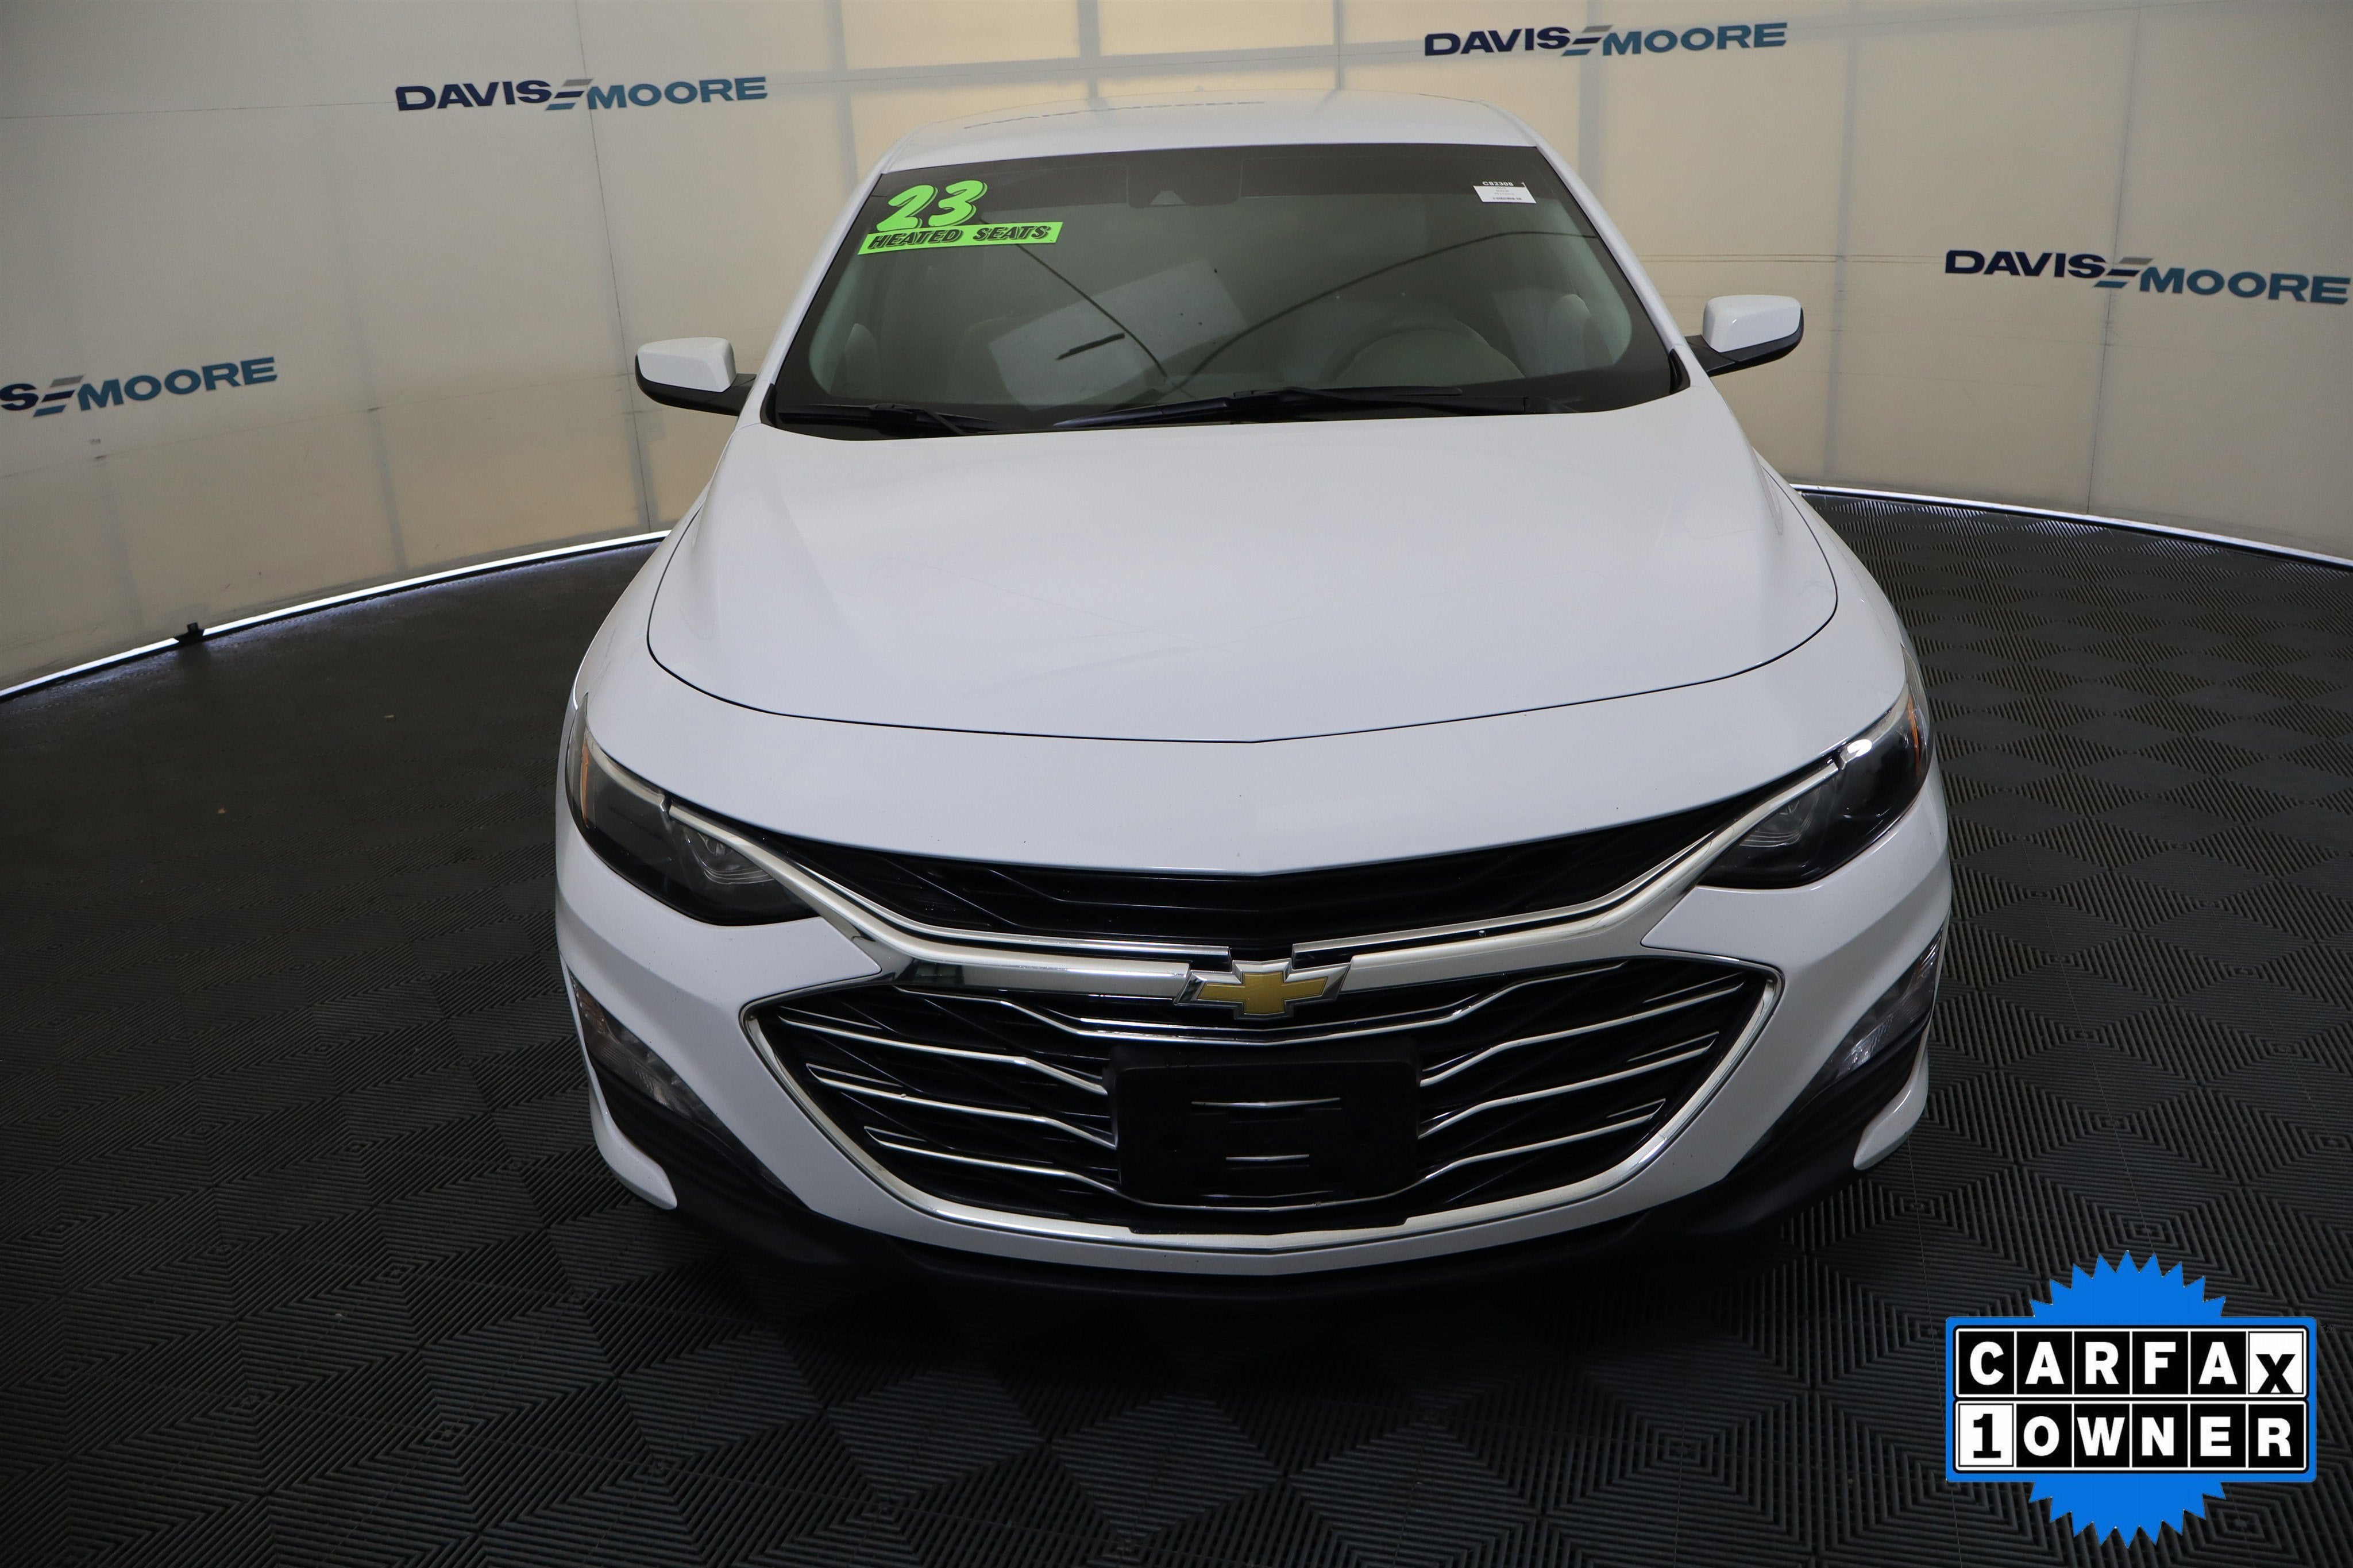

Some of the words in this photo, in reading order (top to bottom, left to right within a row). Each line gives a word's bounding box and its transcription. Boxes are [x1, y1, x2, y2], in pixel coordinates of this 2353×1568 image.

[1425, 26, 1571, 56] DAVIS
[1602, 22, 1788, 56] MOORE
[395, 80, 552, 111] DAVIS
[587, 76, 768, 110] MOORE
[876, 180, 988, 231] 23
[867, 229, 963, 249] HEATED
[972, 225, 1051, 241] SEATS
[1945, 250, 2107, 278] DAVIS
[2139, 266, 2352, 305] MOORE
[77, 356, 278, 411] MOORE
